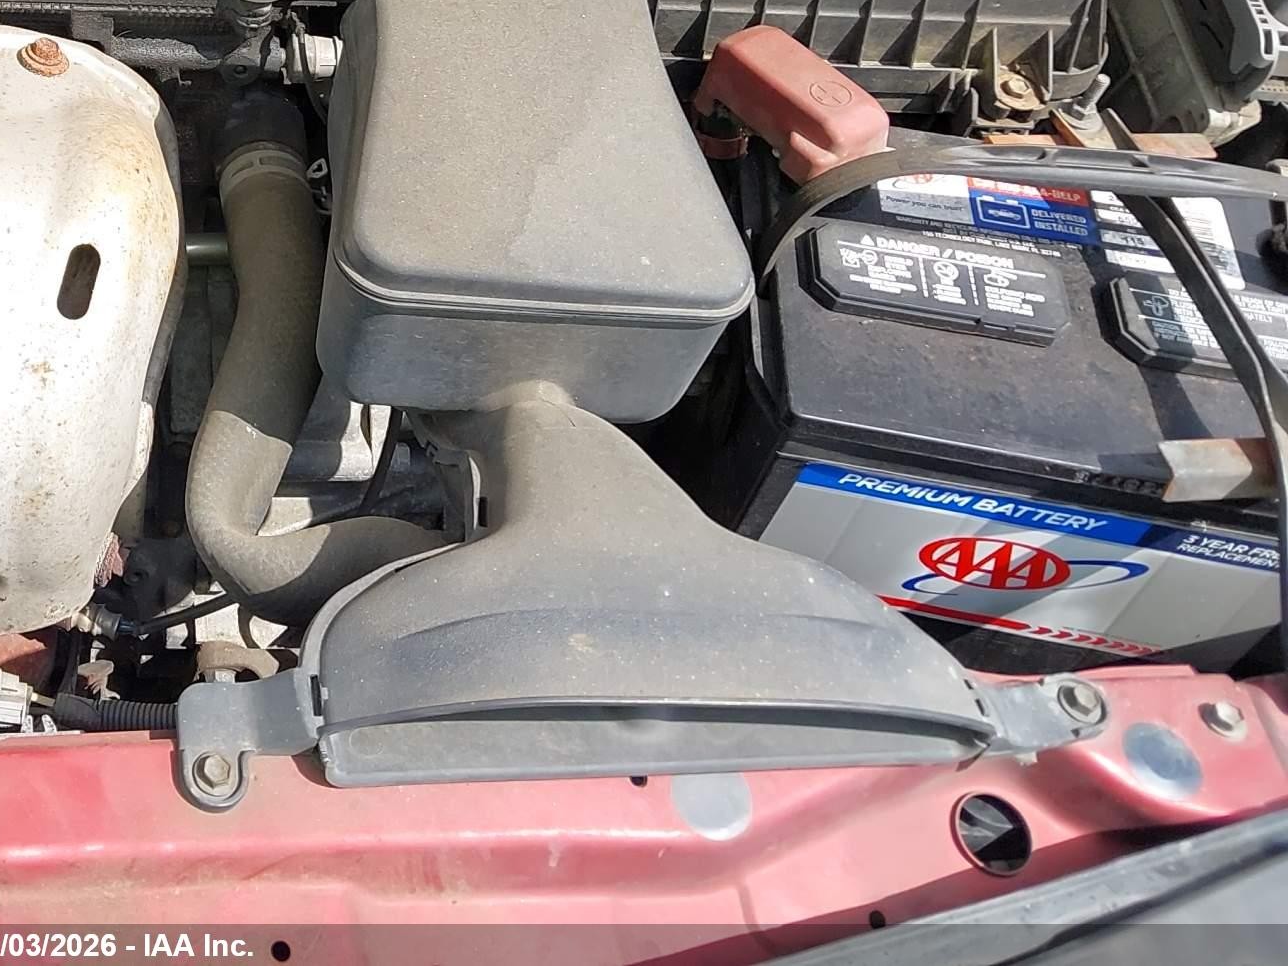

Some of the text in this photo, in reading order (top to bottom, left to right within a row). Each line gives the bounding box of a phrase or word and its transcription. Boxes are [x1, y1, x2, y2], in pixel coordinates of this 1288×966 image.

[1031, 208, 1087, 224] DELIVERED
[1035, 221, 1088, 237] INSTALLED
[875, 237, 941, 257] DANGER
[955, 249, 1015, 269] POISON
[838, 473, 1108, 532] PREMIUM BATTERY
[1182, 535, 1201, 544] 3
[1200, 537, 1250, 554] YEAR
[920, 537, 1068, 590] AAA
